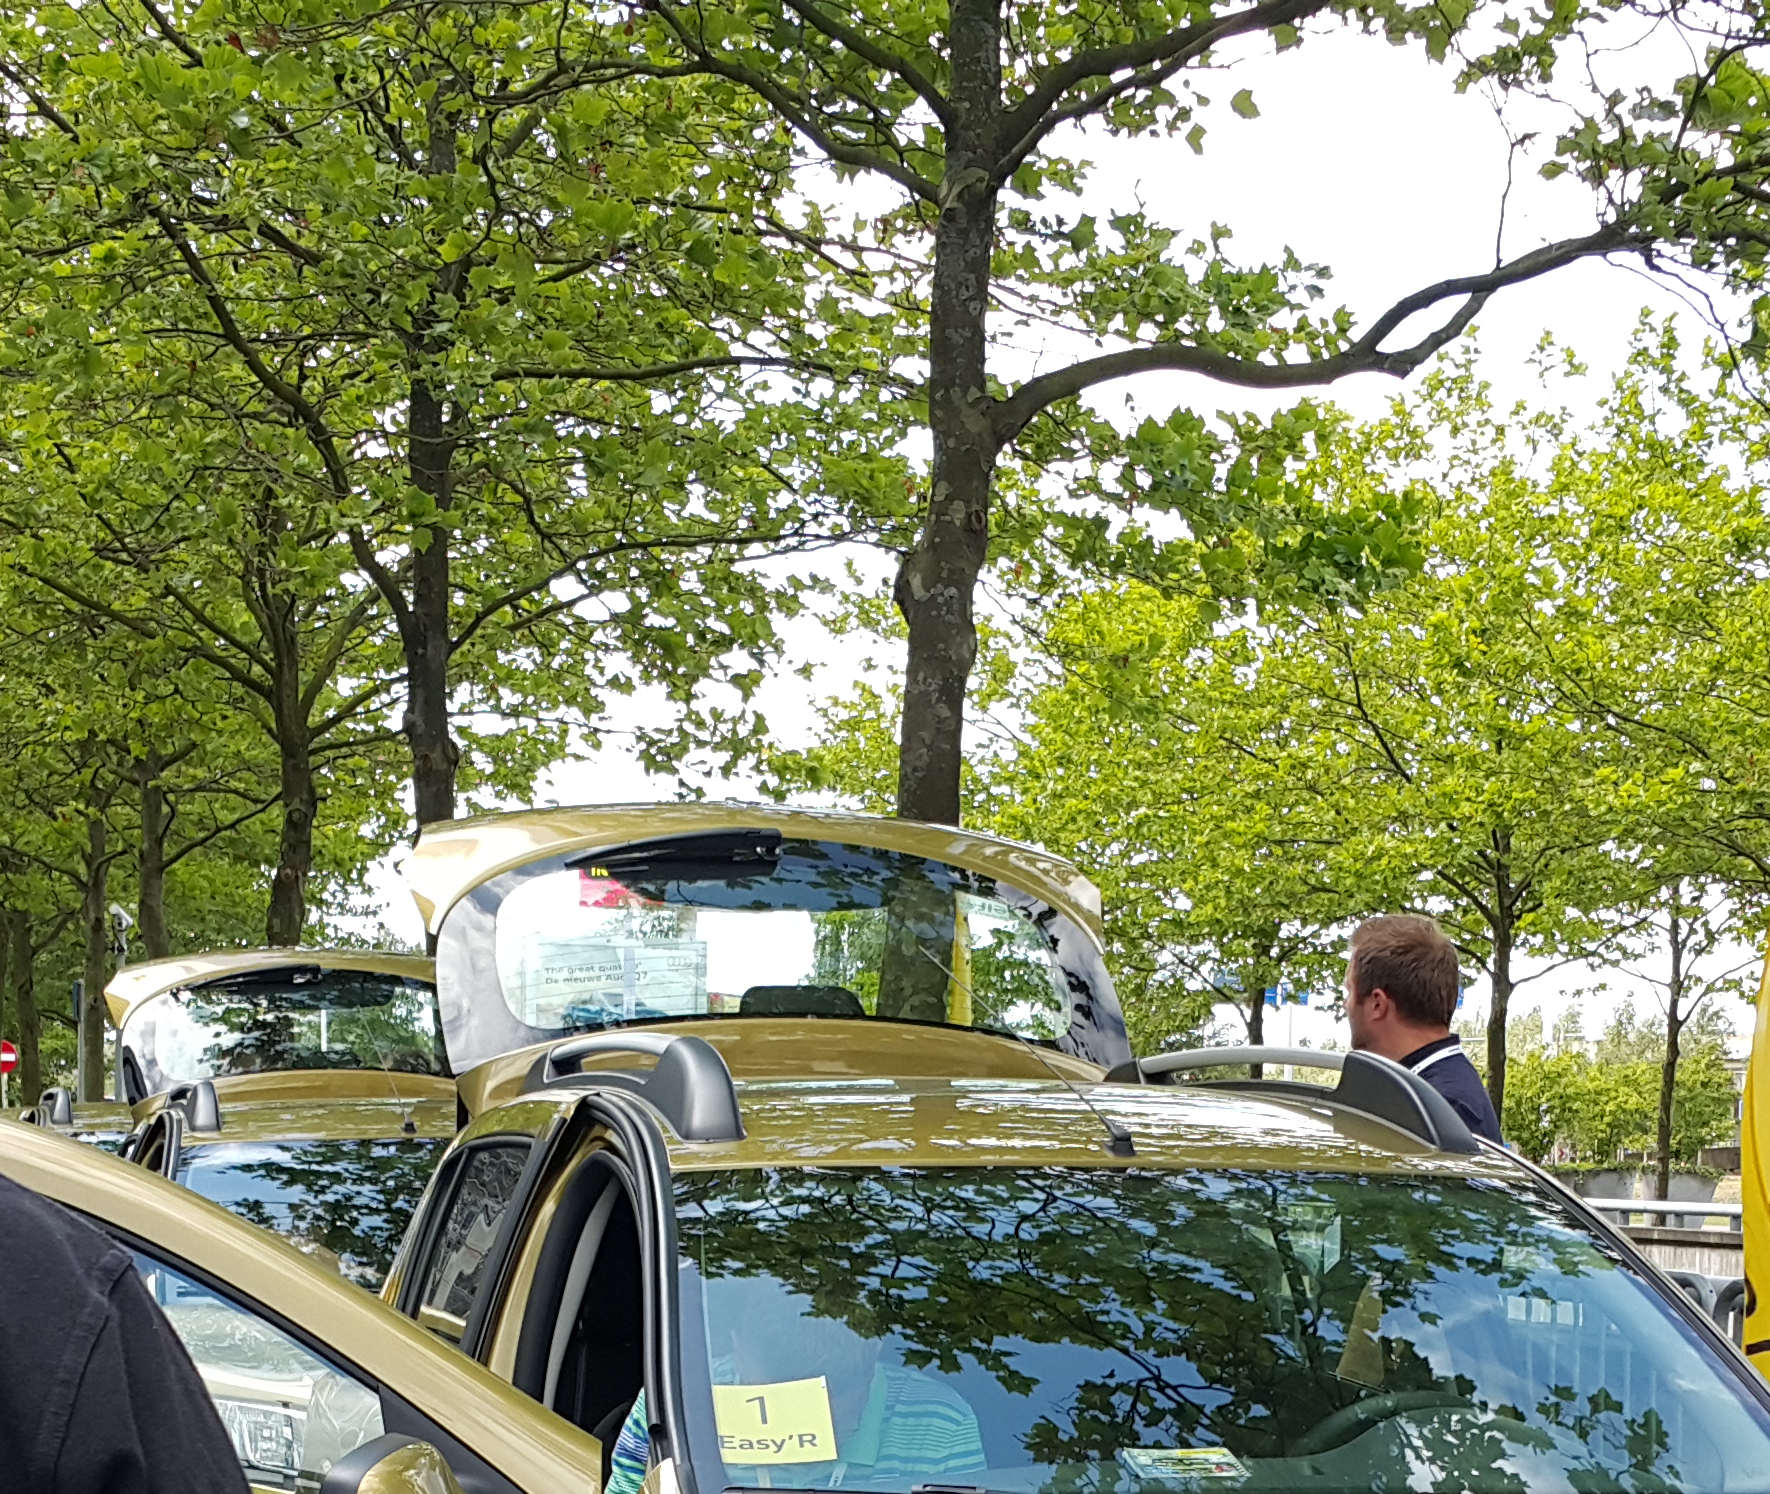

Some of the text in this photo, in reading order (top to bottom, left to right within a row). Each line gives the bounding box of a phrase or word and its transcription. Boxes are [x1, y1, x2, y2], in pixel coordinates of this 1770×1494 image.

[567, 965, 595, 975] great
[745, 1395, 768, 1425] 1
[718, 1433, 818, 1454] Easy'R
